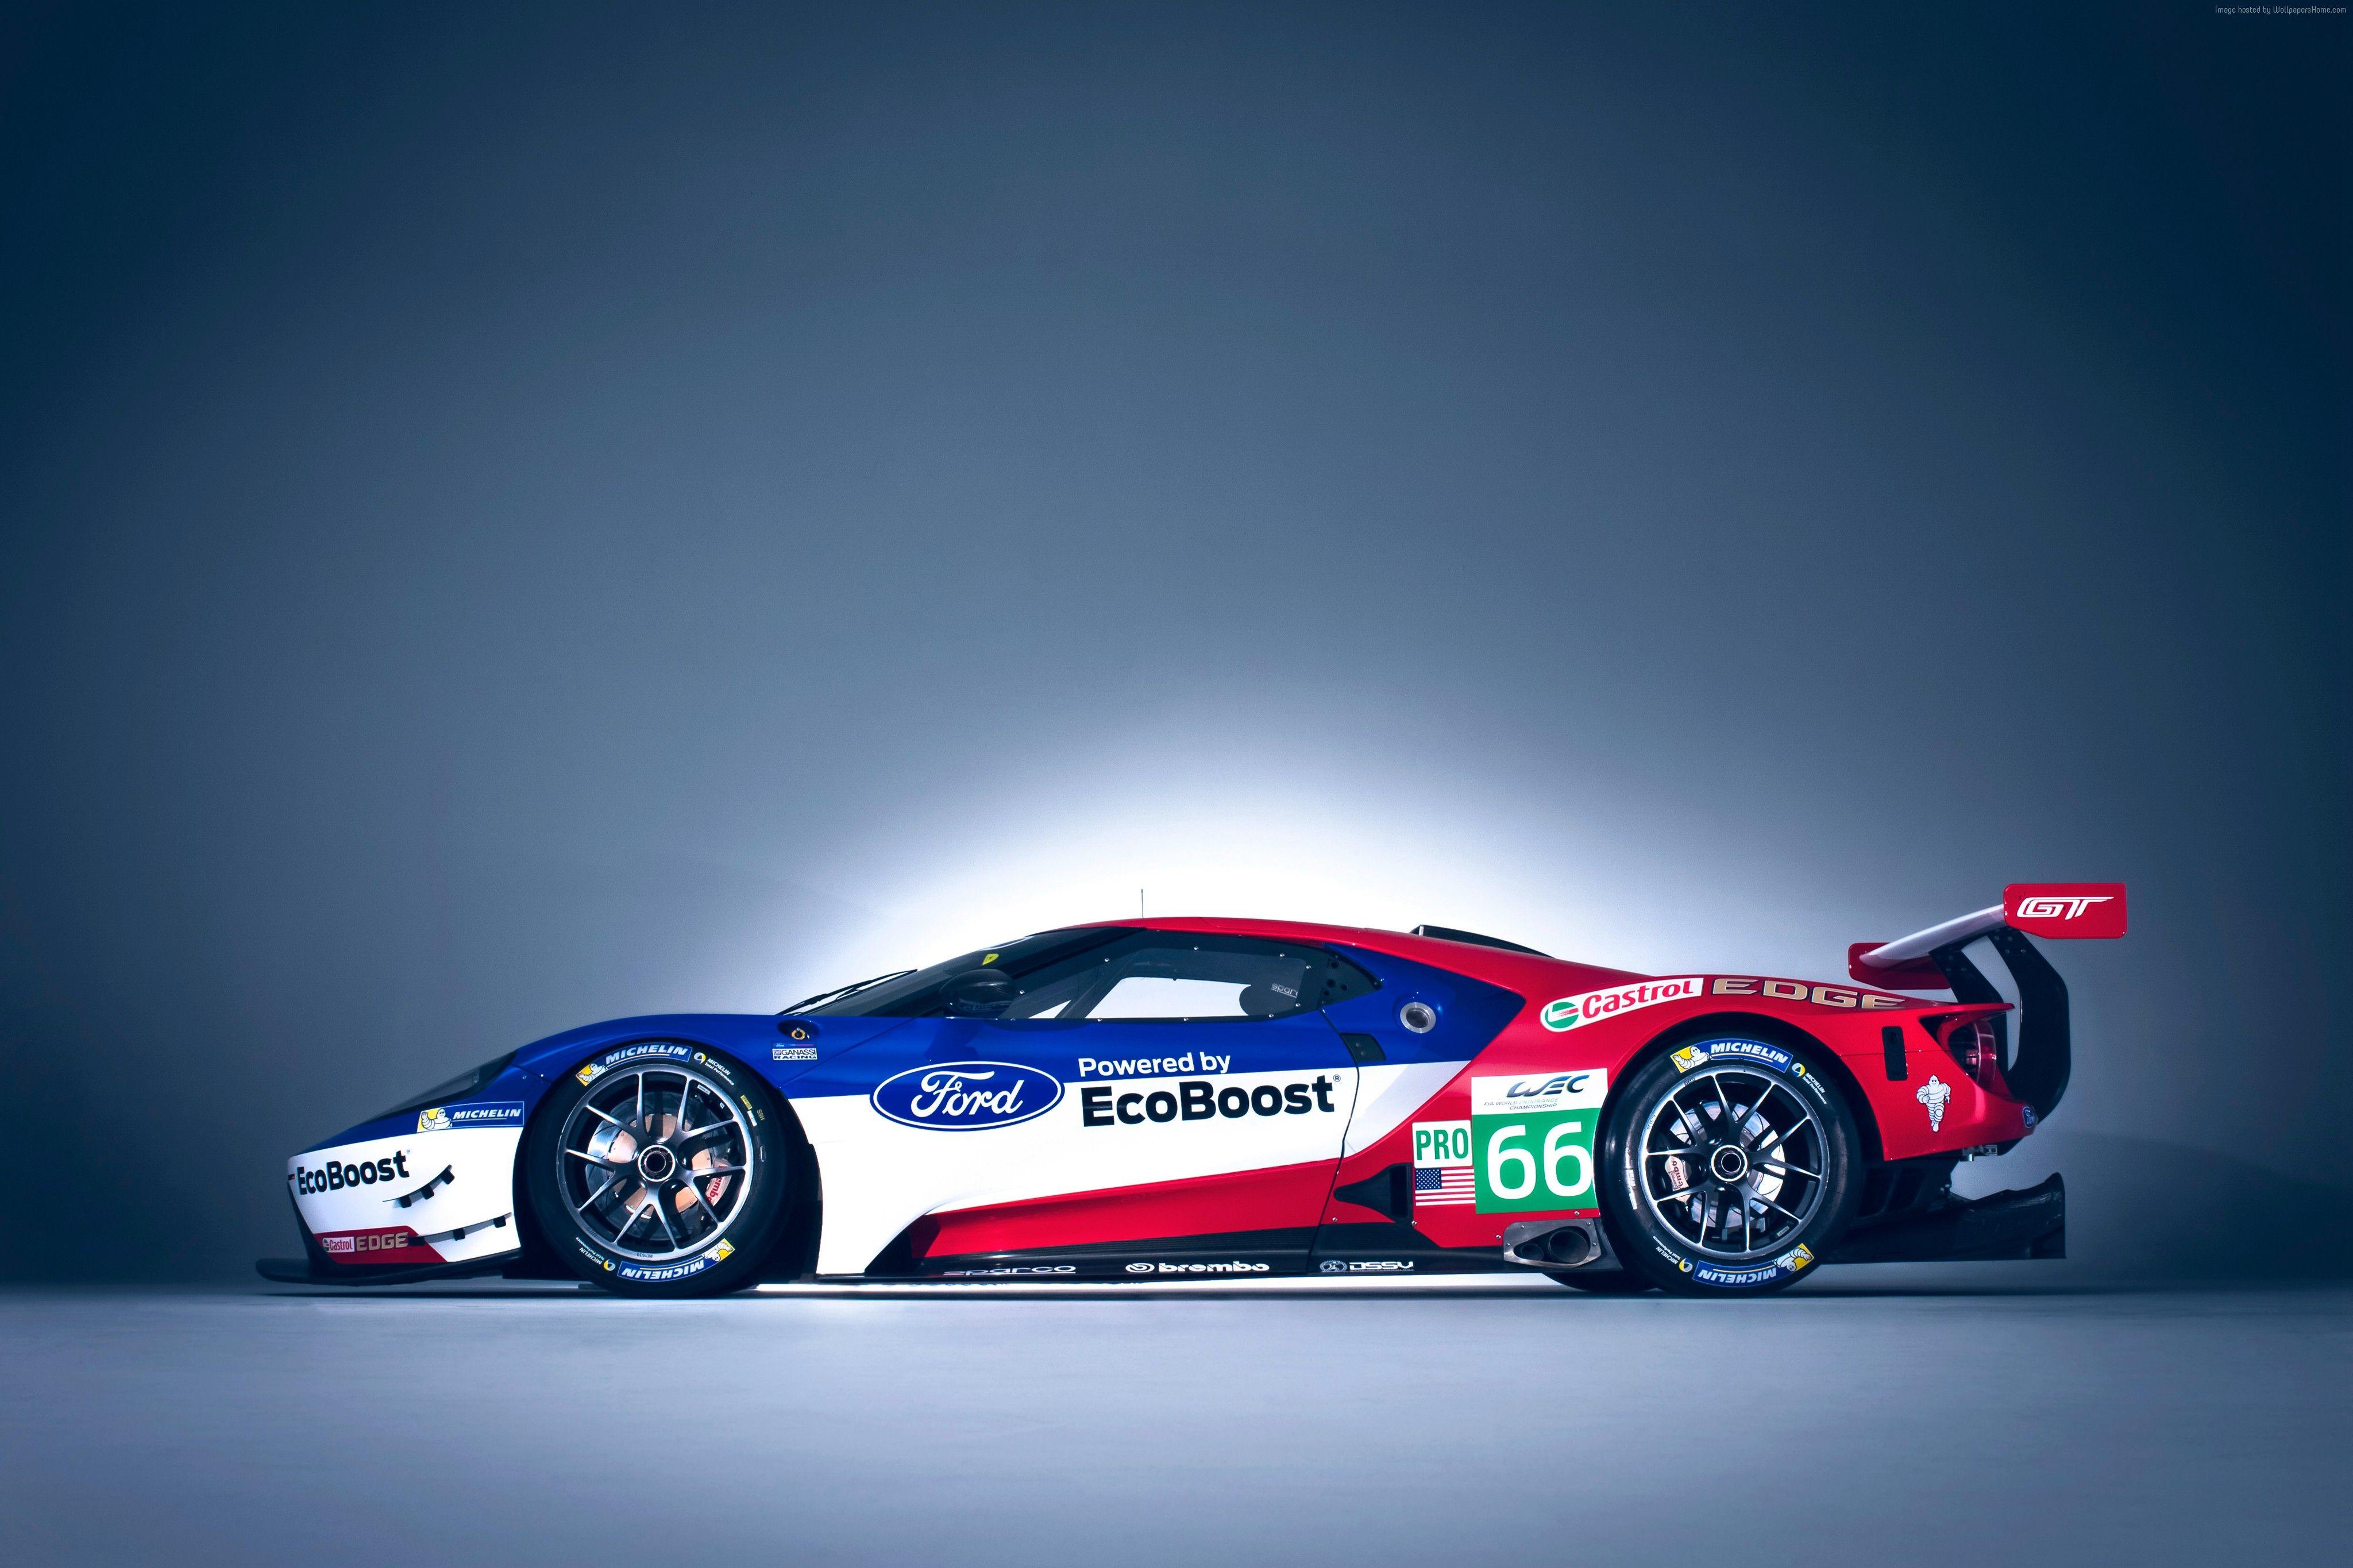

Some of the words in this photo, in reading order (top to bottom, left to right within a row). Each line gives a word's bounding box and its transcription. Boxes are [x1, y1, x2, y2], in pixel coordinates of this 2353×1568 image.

[2017, 897, 2114, 920] GT
[1271, 983, 1299, 997] spar
[1582, 979, 1694, 1018] Castrol
[1712, 978, 1905, 1009] EDGE
[605, 1045, 689, 1065] MICHELIN
[1711, 1042, 1788, 1064] MICHELIN
[707, 1058, 731, 1076] MICHELIN
[1078, 1052, 1195, 1077] Powered
[1199, 1052, 1231, 1074] by
[1506, 1075, 1590, 1098] WEC
[1805, 1072, 1826, 1094] MICHELIN
[911, 1071, 1025, 1118] Ford
[453, 1109, 522, 1119] MICHELIN
[1415, 1127, 1469, 1161] PRO
[1487, 1121, 1594, 1200] 66
[329, 1238, 353, 1251] Castrol
[356, 1231, 409, 1252] EDGE
[579, 1247, 603, 1265] MICHELIN
[1656, 1246, 1679, 1264] MICHELIN
[622, 1260, 704, 1280] MICHELIN
[943, 1265, 1076, 1276] sparco
[1159, 1261, 1270, 1272] brembo
[1349, 1261, 1414, 1270] DSSV
[1697, 1267, 1777, 1283] MICHELIN
